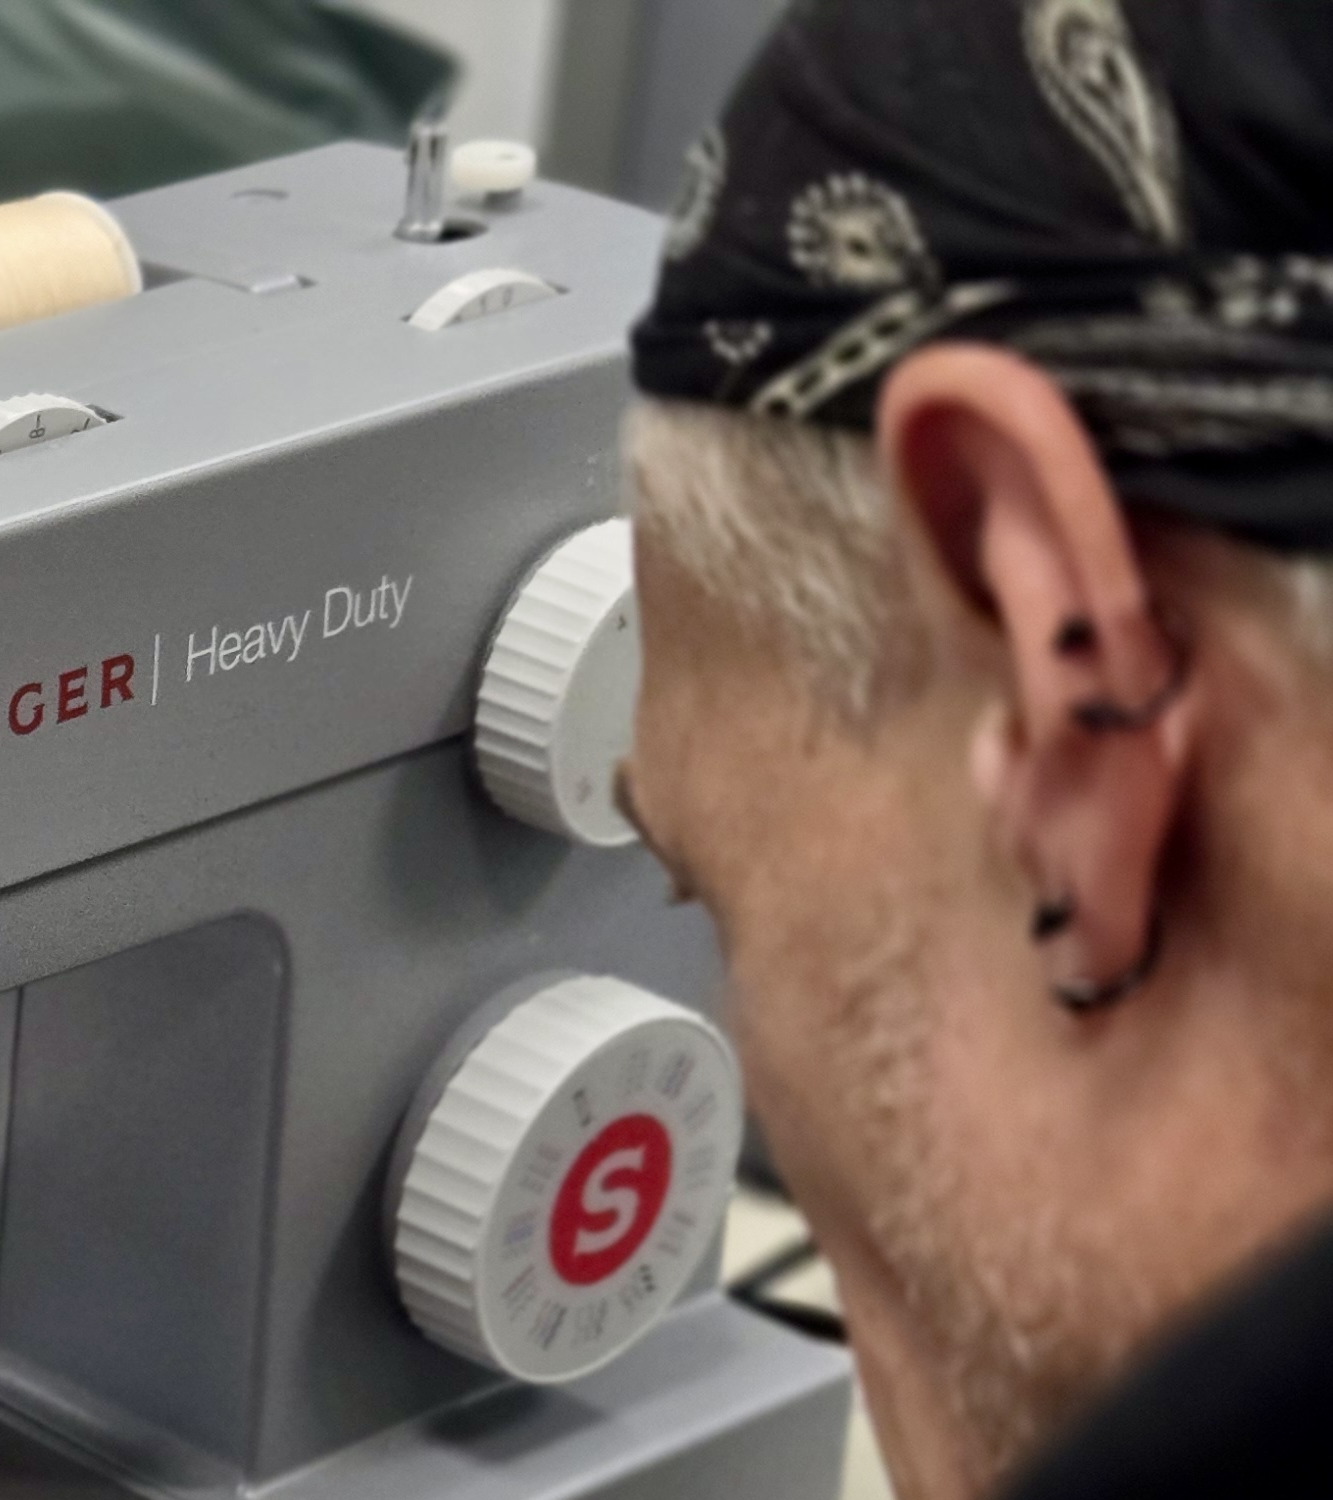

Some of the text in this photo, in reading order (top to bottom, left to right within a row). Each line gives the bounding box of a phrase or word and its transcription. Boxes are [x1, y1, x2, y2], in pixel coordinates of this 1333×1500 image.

[184, 610, 311, 683] Heavy
[322, 575, 413, 639] Duty
[573, 1147, 645, 1257] S
